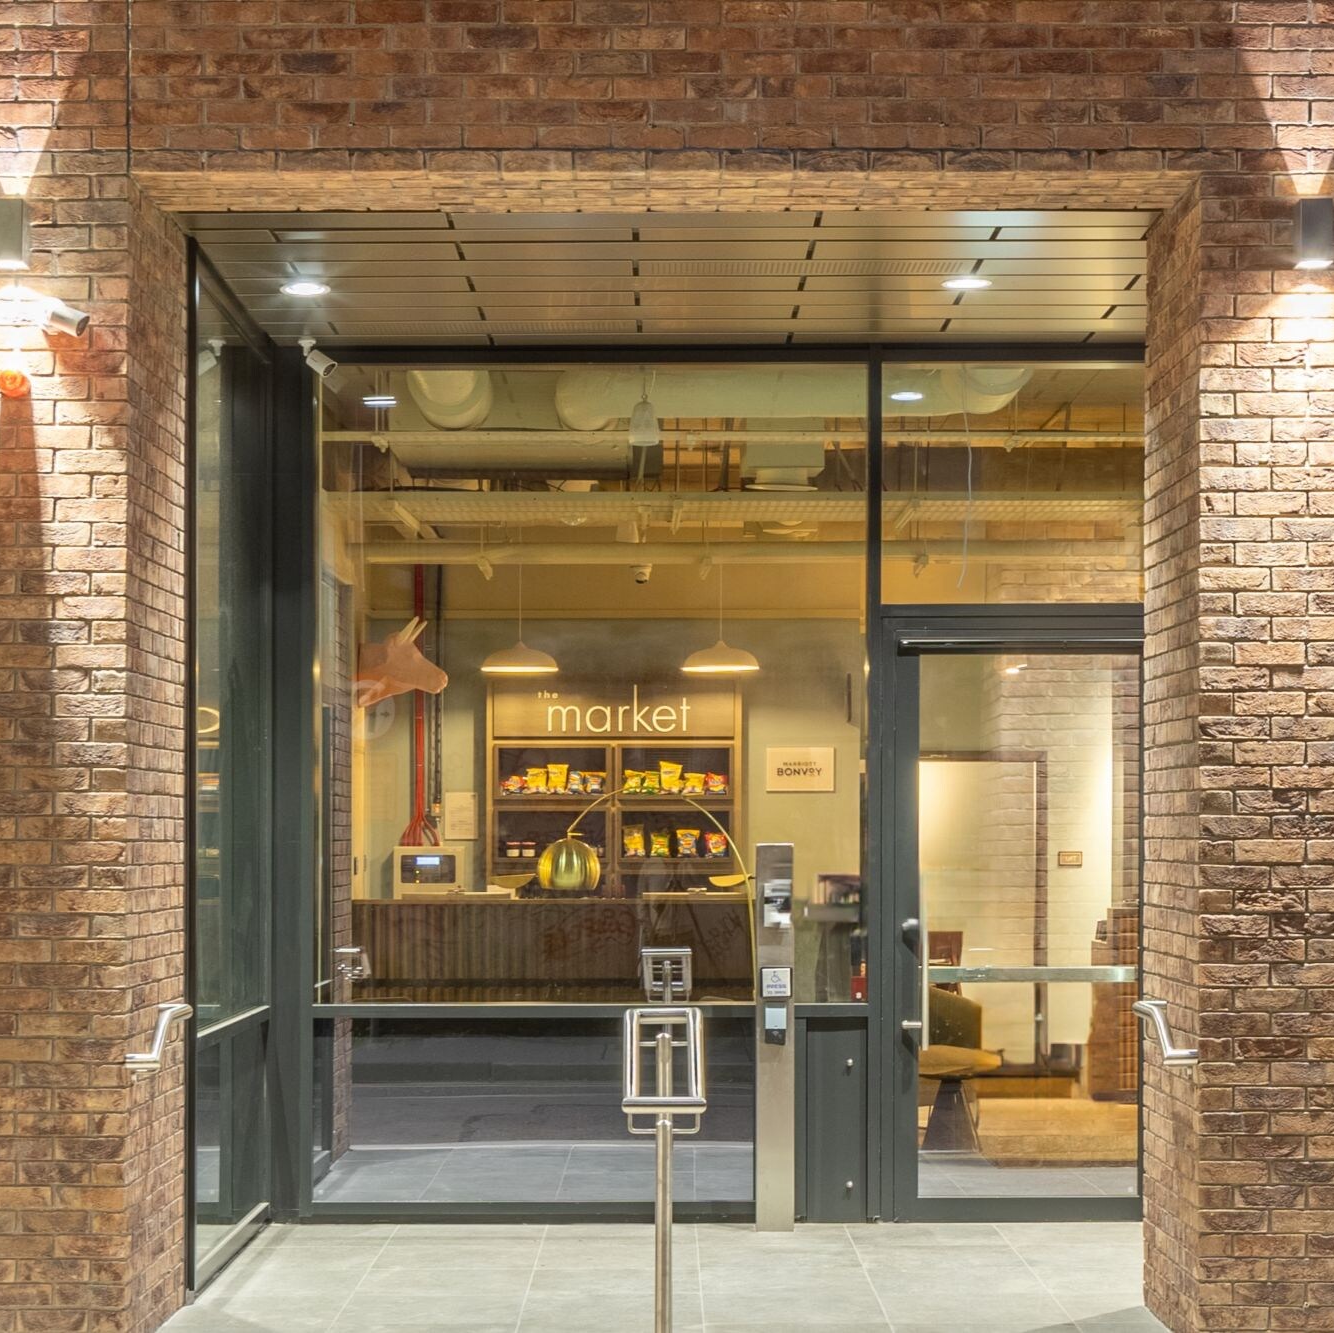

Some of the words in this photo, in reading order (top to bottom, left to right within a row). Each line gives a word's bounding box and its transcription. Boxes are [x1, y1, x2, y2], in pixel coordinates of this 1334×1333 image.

[537, 690, 559, 699] the
[547, 684, 691, 733] market
[776, 767, 822, 777] BONVOY
